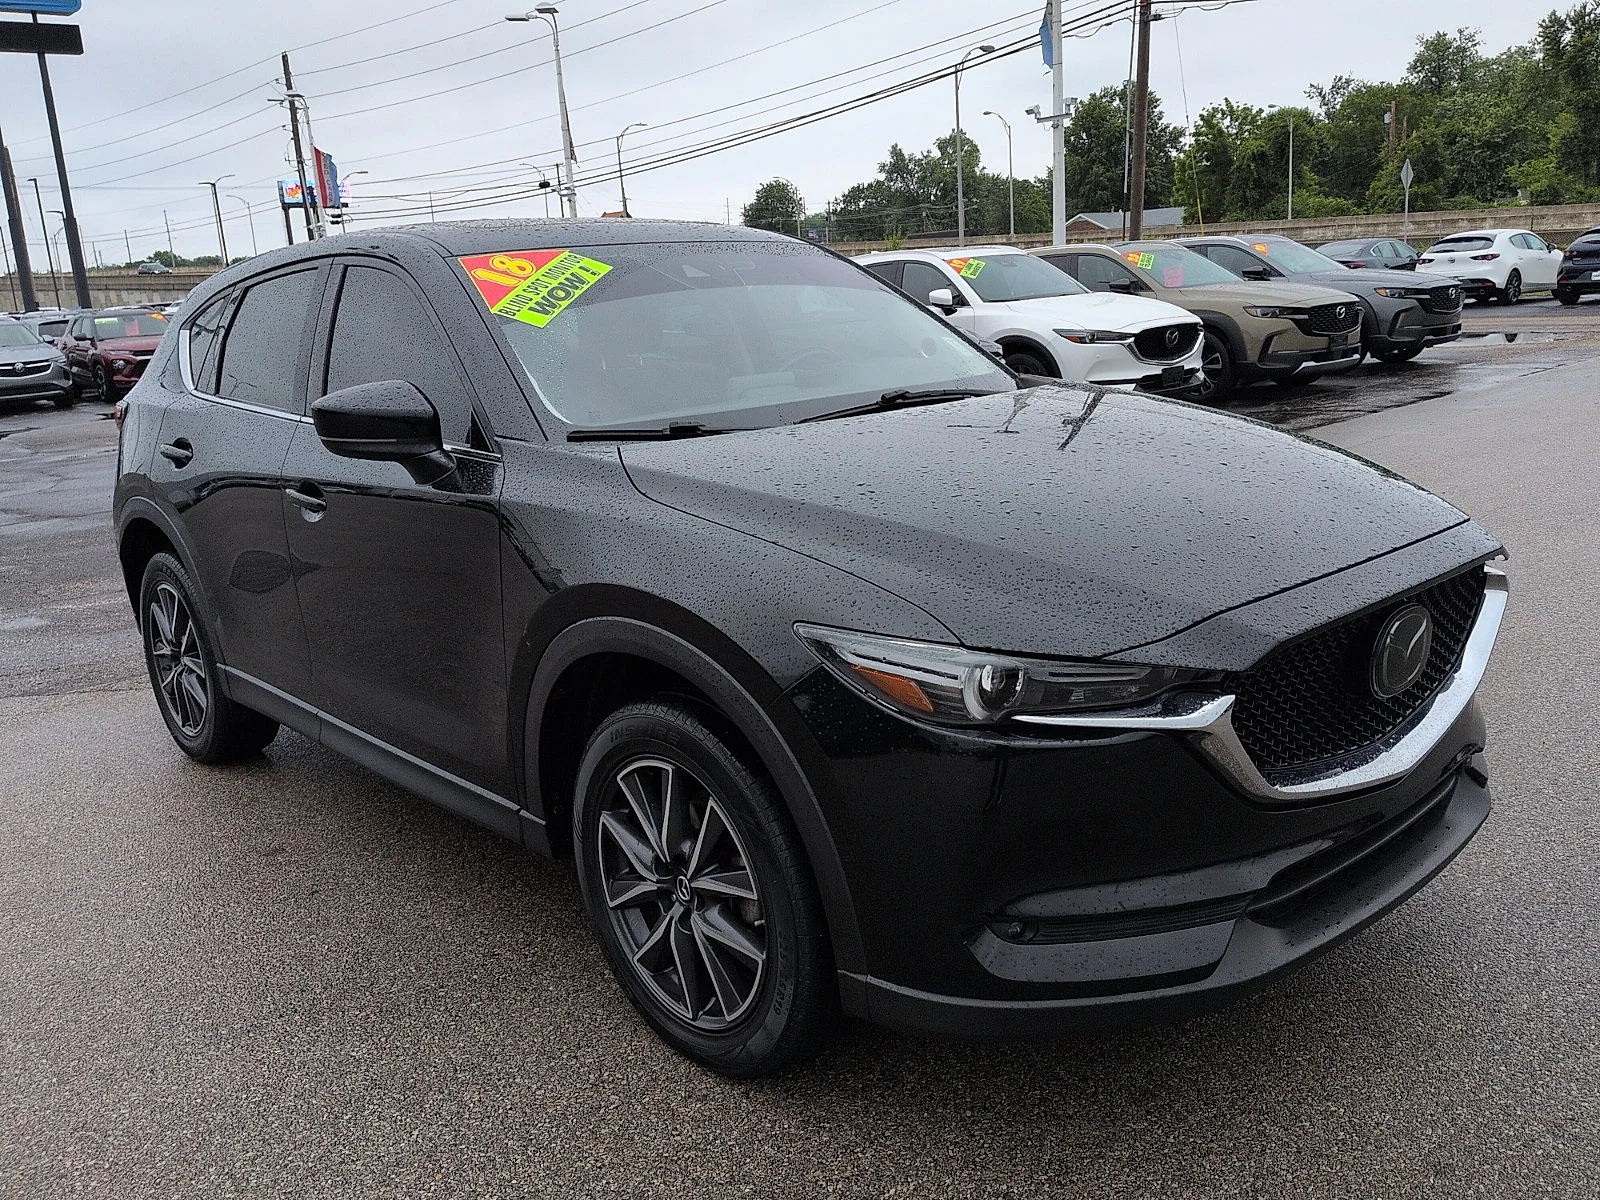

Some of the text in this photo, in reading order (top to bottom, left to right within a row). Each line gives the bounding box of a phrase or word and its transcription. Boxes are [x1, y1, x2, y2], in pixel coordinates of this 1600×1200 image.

[471, 254, 537, 287] 18
[498, 253, 586, 317] BLIND SPOT MONITOR
